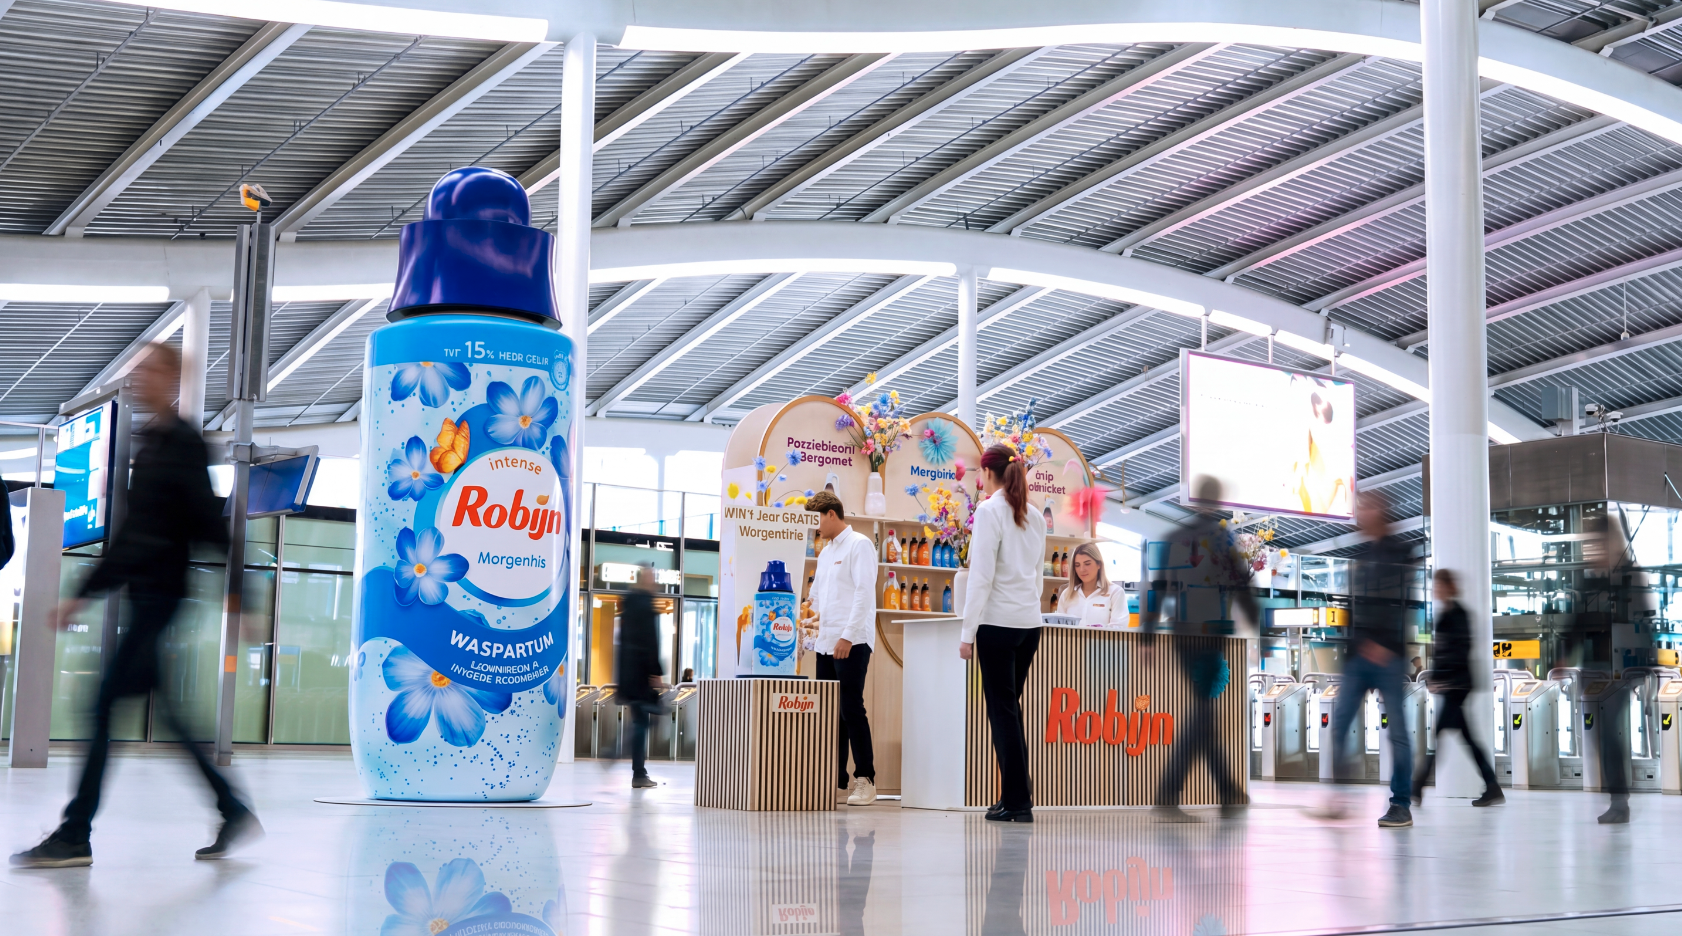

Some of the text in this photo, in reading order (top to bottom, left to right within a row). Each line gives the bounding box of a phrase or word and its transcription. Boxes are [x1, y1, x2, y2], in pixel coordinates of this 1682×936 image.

[488, 457, 542, 476] intense
[452, 485, 562, 540] Robijn
[782, 512, 820, 526] GRATIS
[477, 551, 546, 569] Morgenhis
[450, 629, 554, 659] WASPARTUM
[778, 695, 815, 712] Robijn
[1045, 687, 1175, 757] Robijn
